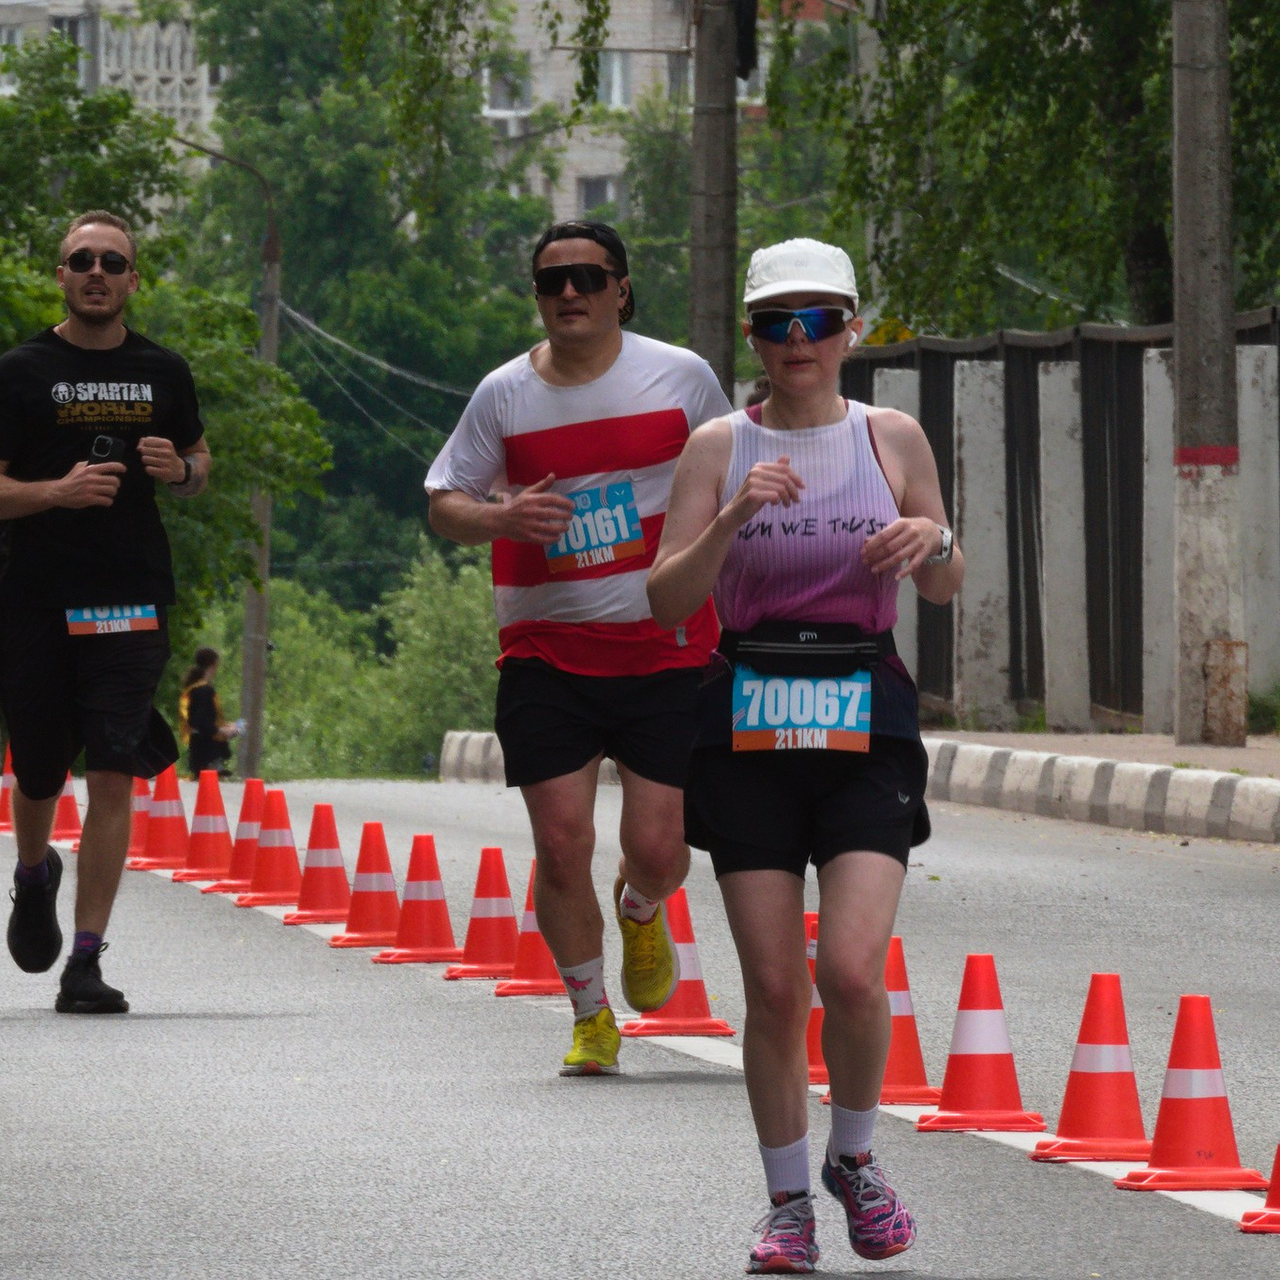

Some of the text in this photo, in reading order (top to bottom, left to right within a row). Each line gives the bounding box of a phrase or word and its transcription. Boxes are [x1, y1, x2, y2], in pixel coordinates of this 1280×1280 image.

[75, 382, 153, 402] SPARTAN
[56, 402, 153, 418] WORLD
[56, 415, 152, 425] CHAMPIONSHIP
[781, 518, 818, 537] WE
[575, 545, 615, 568] 21.1KM
[96, 618, 131, 634] 21.1KM
[799, 631, 818, 642] gm
[742, 678, 863, 727] 70067
[775, 728, 827, 750] 21.1KM
